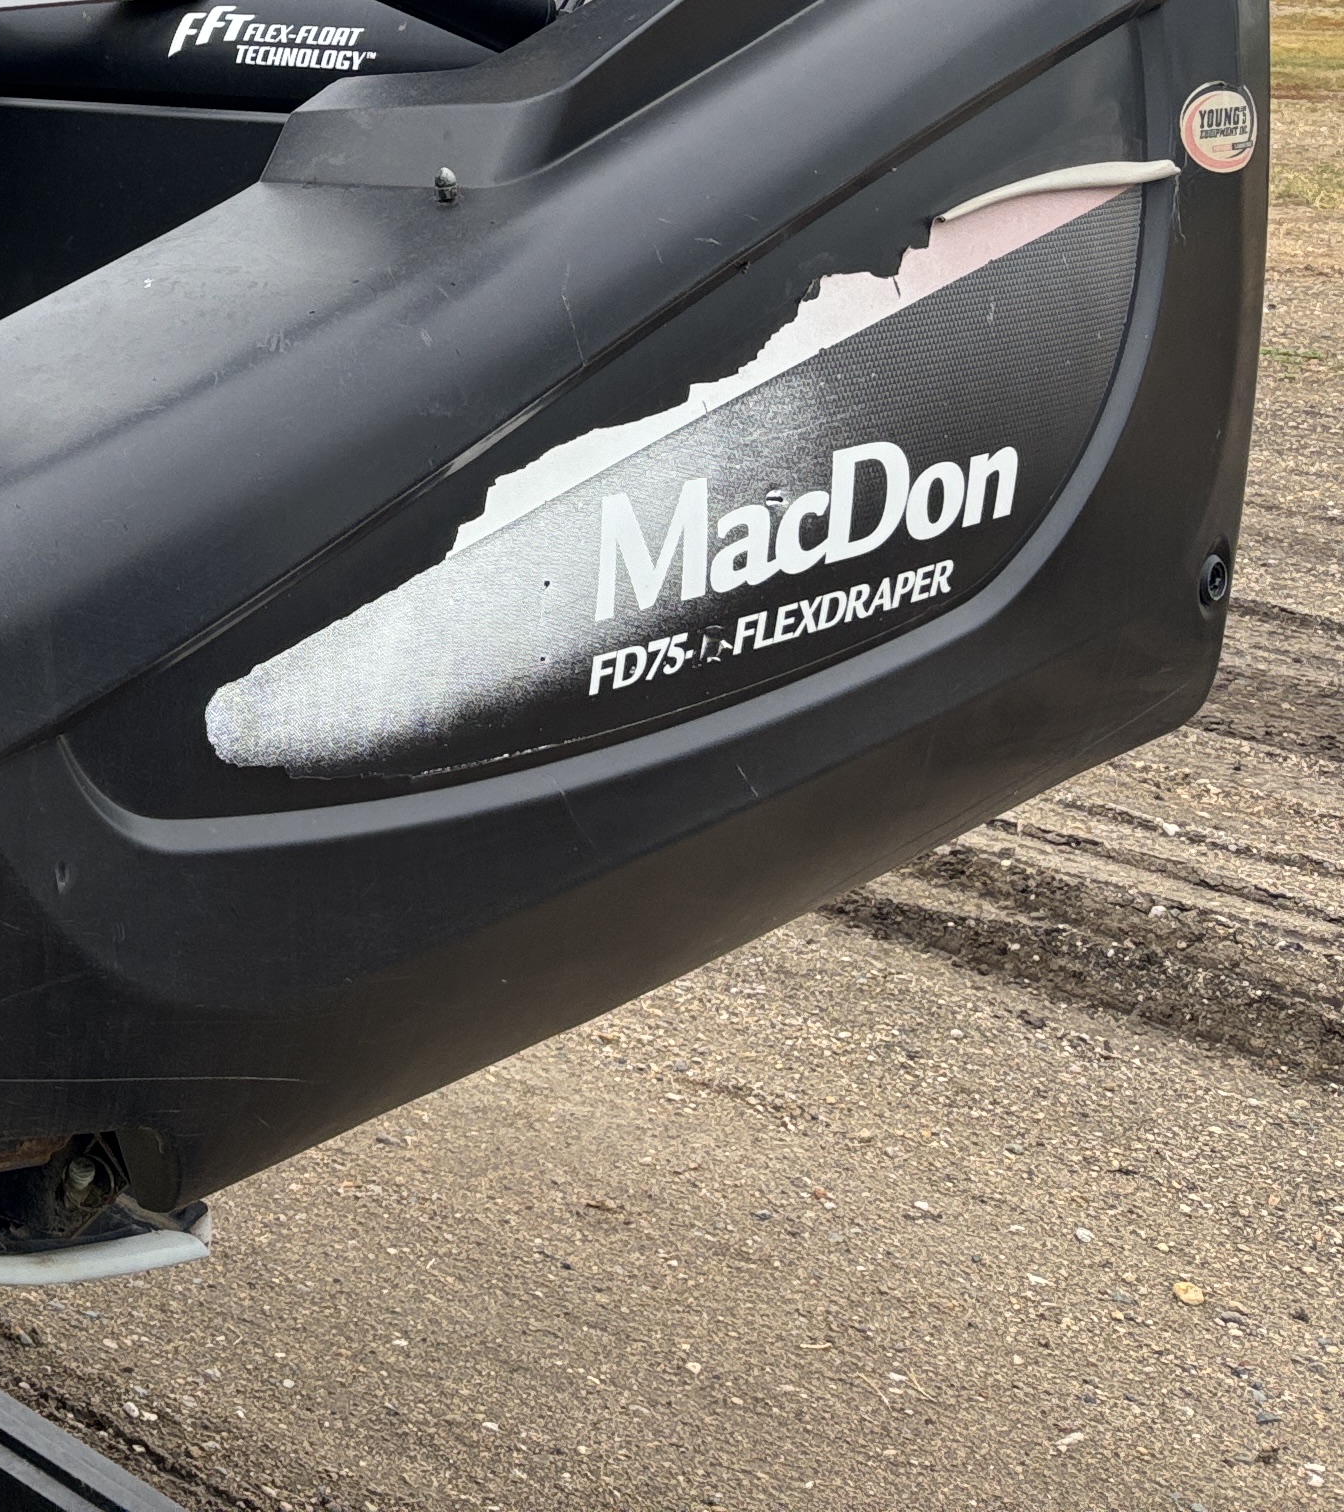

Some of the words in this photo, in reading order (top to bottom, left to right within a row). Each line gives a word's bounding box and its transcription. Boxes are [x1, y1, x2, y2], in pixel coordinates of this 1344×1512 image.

[168, 5, 257, 58] FFT
[243, 22, 366, 47] FLEX-FLOAT
[593, 440, 1019, 623] MacDon
[733, 559, 954, 655] FLEXDRAPER
